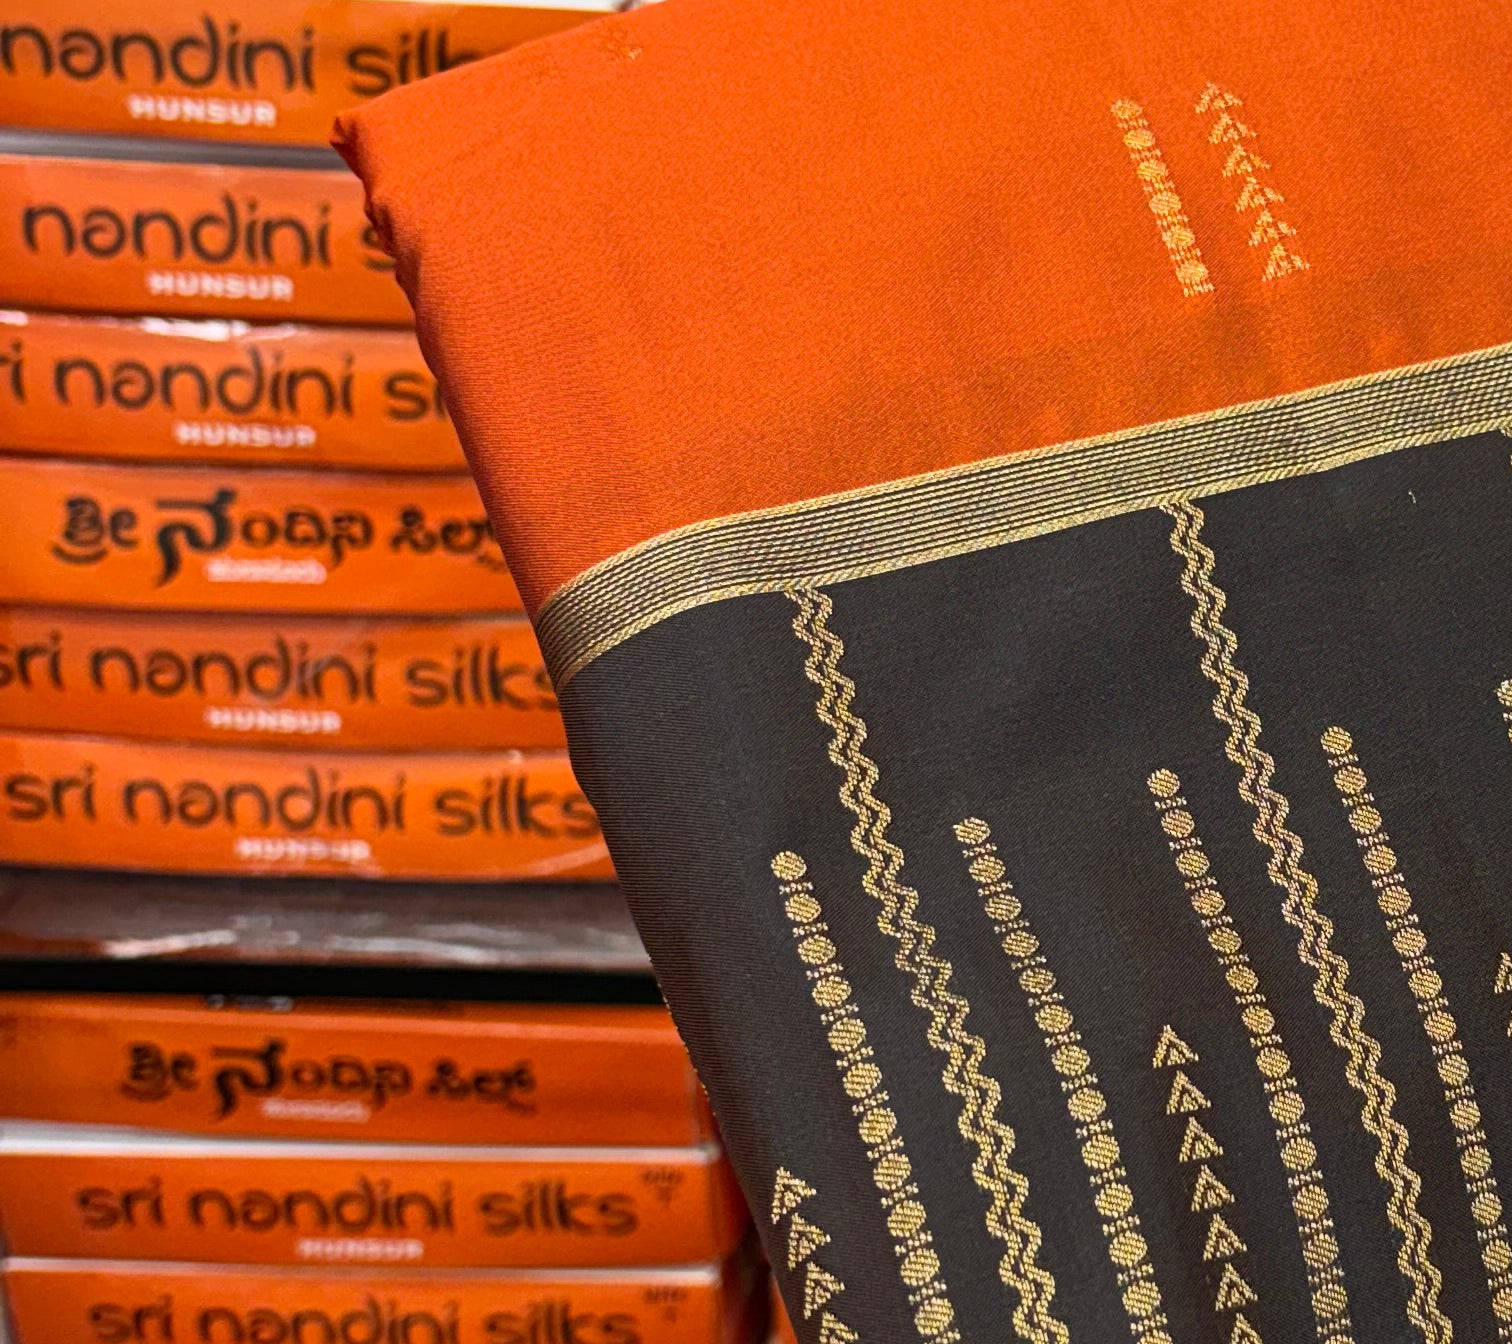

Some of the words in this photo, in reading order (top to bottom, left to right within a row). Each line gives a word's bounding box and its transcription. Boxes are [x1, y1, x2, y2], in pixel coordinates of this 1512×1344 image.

[0, 17, 314, 90] nandini
[129, 95, 276, 124] HUNSUR
[22, 195, 330, 267] nandini
[147, 272, 293, 298] HUNSUR
[53, 348, 353, 416] nandini
[156, 487, 374, 585] ನಂದಿನಿ
[89, 637, 376, 700] nandini
[3, 768, 95, 821] sri
[122, 767, 405, 833] nandini
[434, 768, 598, 839] silks
[74, 1183, 164, 1230] sri
[186, 1179, 454, 1236] nandini
[478, 1182, 639, 1238] silks
